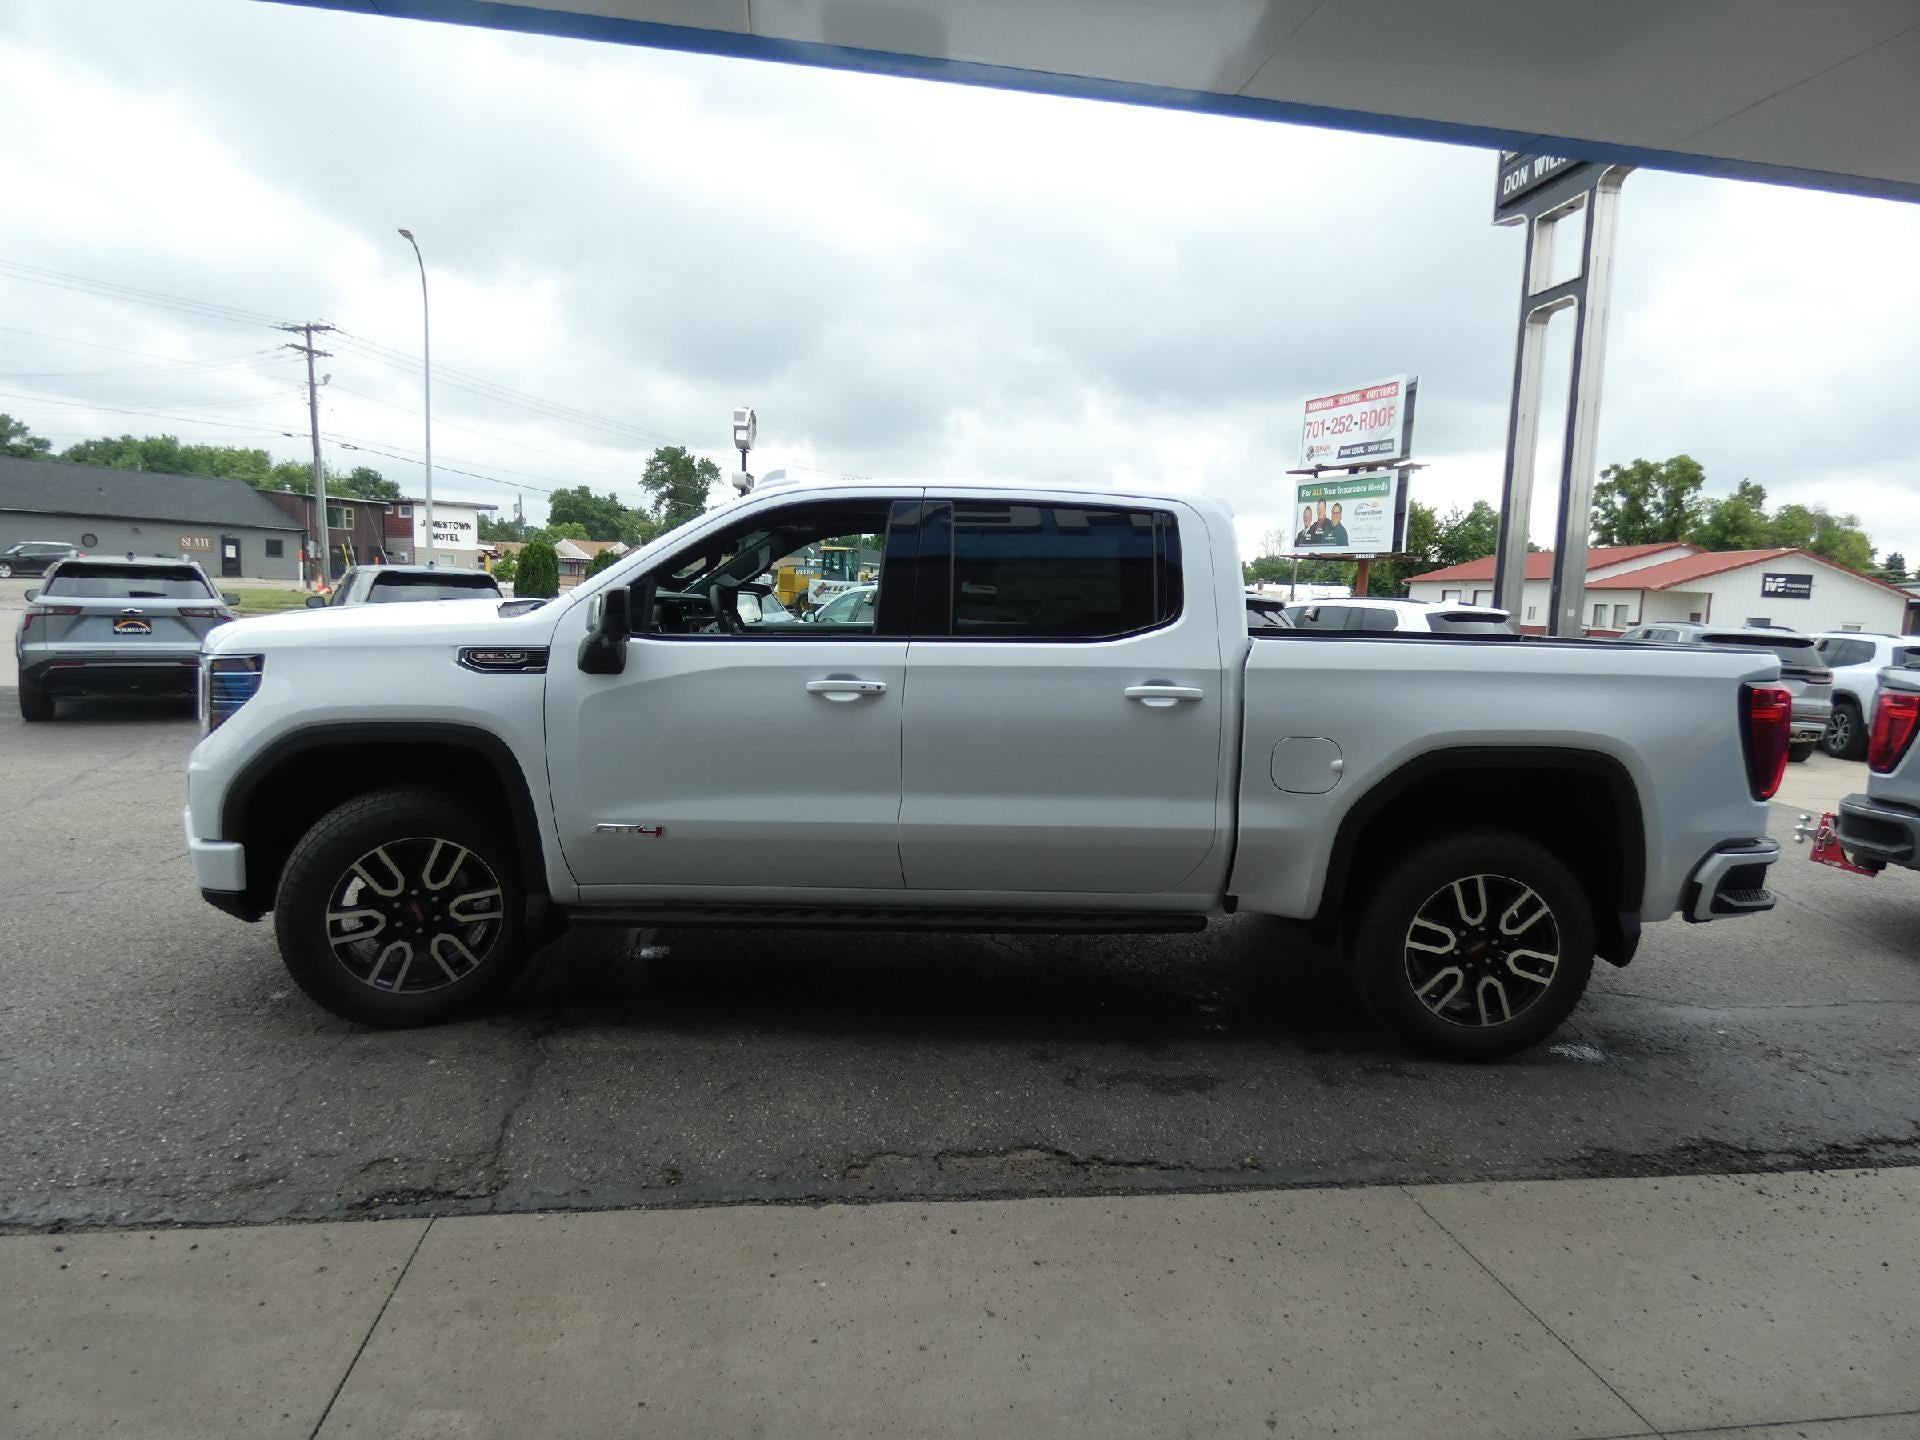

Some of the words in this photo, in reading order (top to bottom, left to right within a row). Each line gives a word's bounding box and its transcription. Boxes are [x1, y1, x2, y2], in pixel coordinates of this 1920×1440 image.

[1503, 165, 1528, 196] DON
[1339, 393, 1360, 405] SIDING
[1366, 385, 1396, 399] GUTTERS
[1306, 406, 1395, 439] 701-252-ROOF
[1301, 488, 1312, 498] For
[1312, 487, 1323, 496] ALL
[1324, 485, 1337, 495] Your
[1337, 483, 1368, 494] Insurance
[1368, 481, 1389, 491] Needs
[420, 519, 472, 530] JMESTOWN
[432, 532, 460, 542] MOTEL
